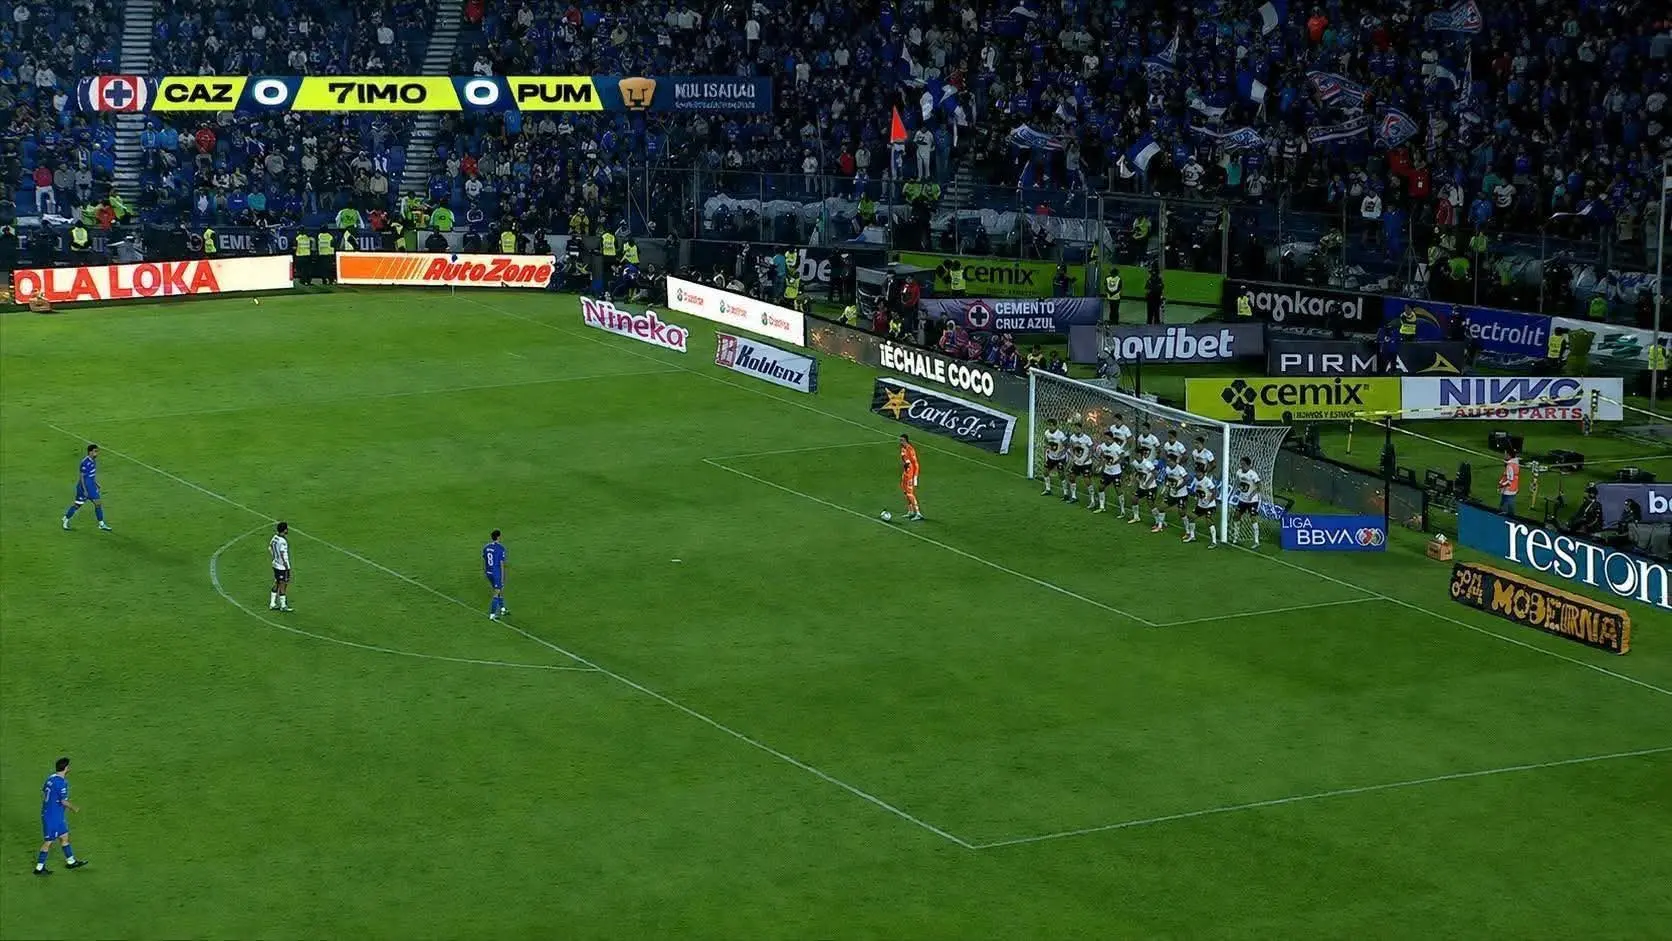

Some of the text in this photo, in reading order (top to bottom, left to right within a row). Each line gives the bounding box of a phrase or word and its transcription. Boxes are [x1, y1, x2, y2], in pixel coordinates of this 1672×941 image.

[14, 259, 220, 303] OLA LOKA
[424, 256, 552, 284] AutoZone
[963, 263, 1034, 286] cemix
[995, 301, 1055, 315] CEMENTO
[585, 299, 684, 348] Nineka
[995, 317, 1056, 330] CRUZ AZUL
[1466, 317, 1545, 347] ectrolit
[735, 344, 805, 385] Koblenz
[879, 340, 994, 398] ¡ÉCHALE COCO
[1260, 378, 1364, 406] cemix
[908, 398, 960, 430] Carl's
[1518, 407, 1583, 419] PARTS
[1281, 517, 1313, 529] LIGA
[1297, 530, 1354, 545] BBVA
[487, 552, 494, 566] 8
[1505, 521, 1672, 610] reston
